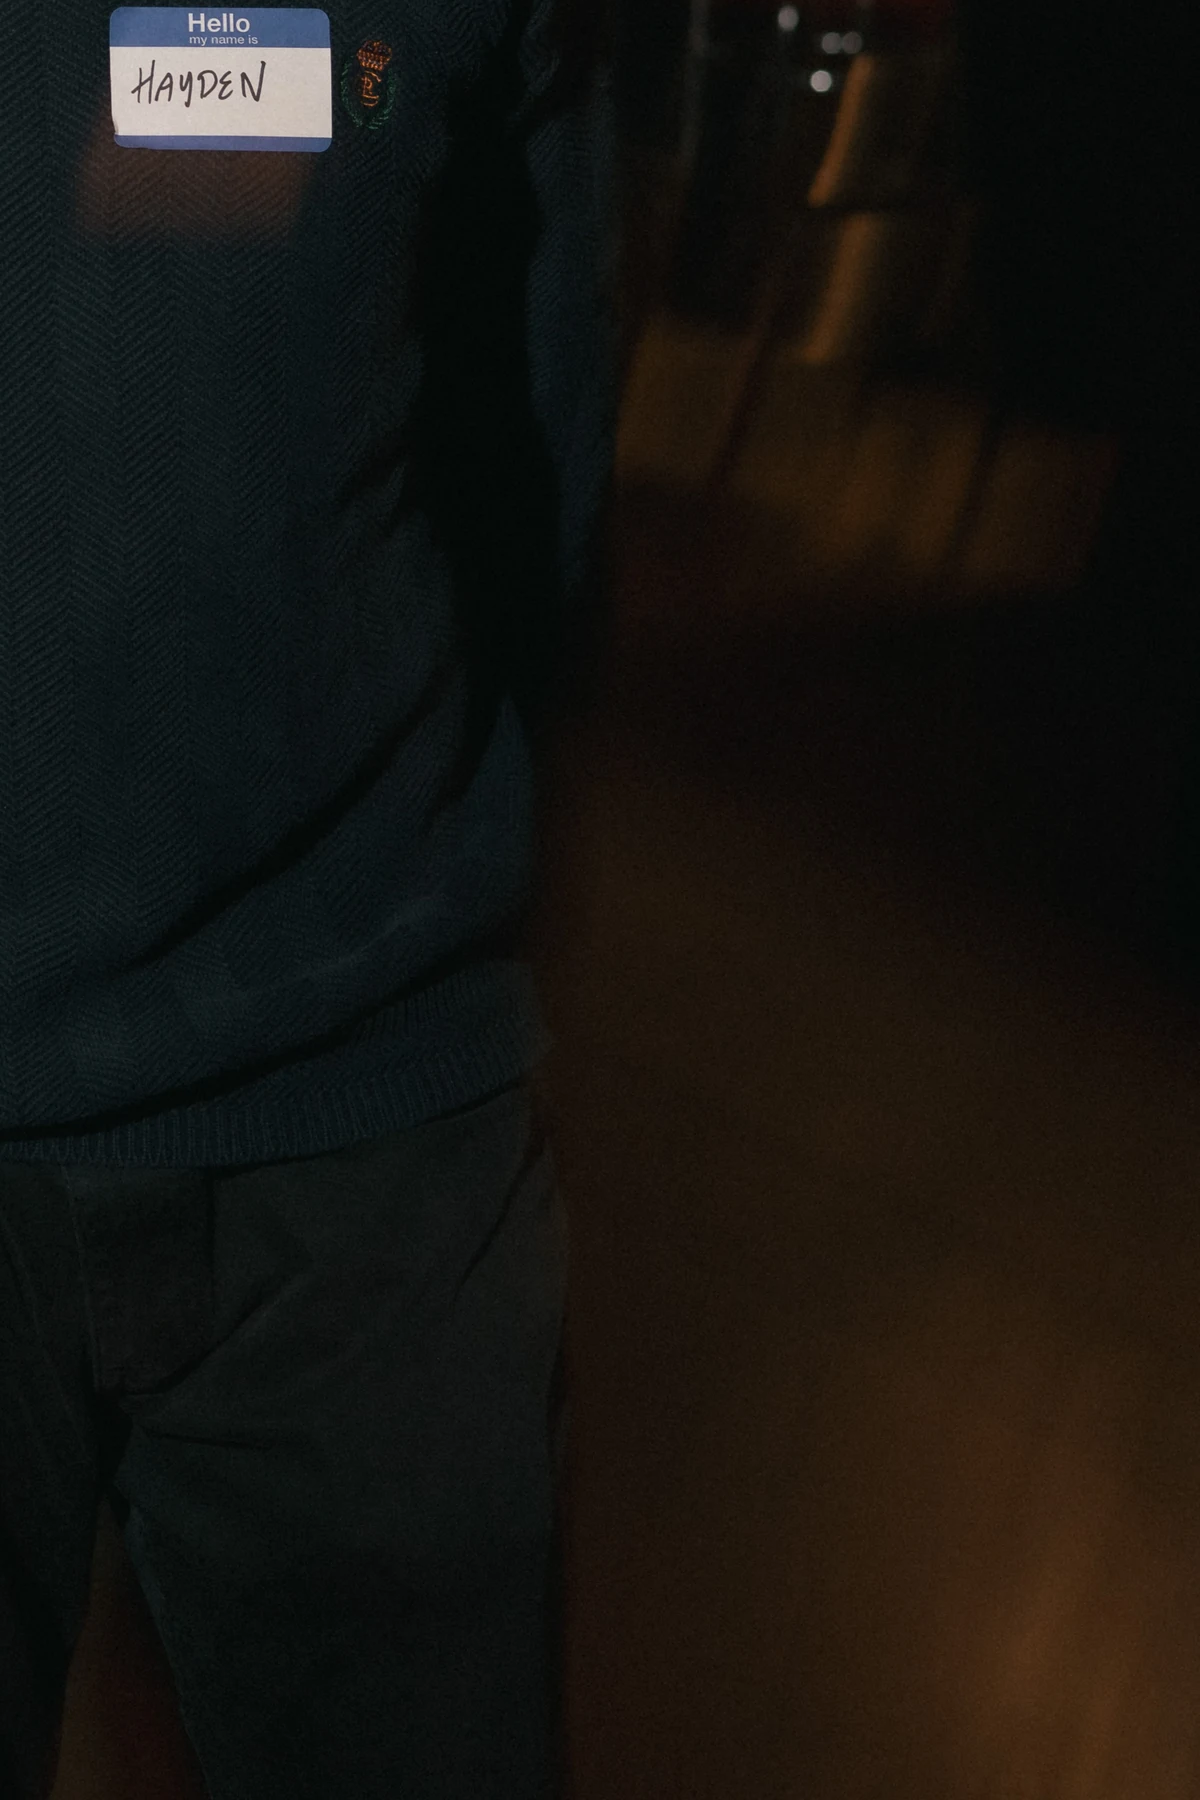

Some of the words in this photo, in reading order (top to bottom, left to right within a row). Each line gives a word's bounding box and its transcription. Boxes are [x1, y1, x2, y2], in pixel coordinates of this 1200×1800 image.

[188, 12, 251, 33] Hello
[189, 36, 207, 46] my
[211, 36, 245, 45] name
[248, 34, 259, 45] is
[131, 59, 267, 107] HAYDEN
